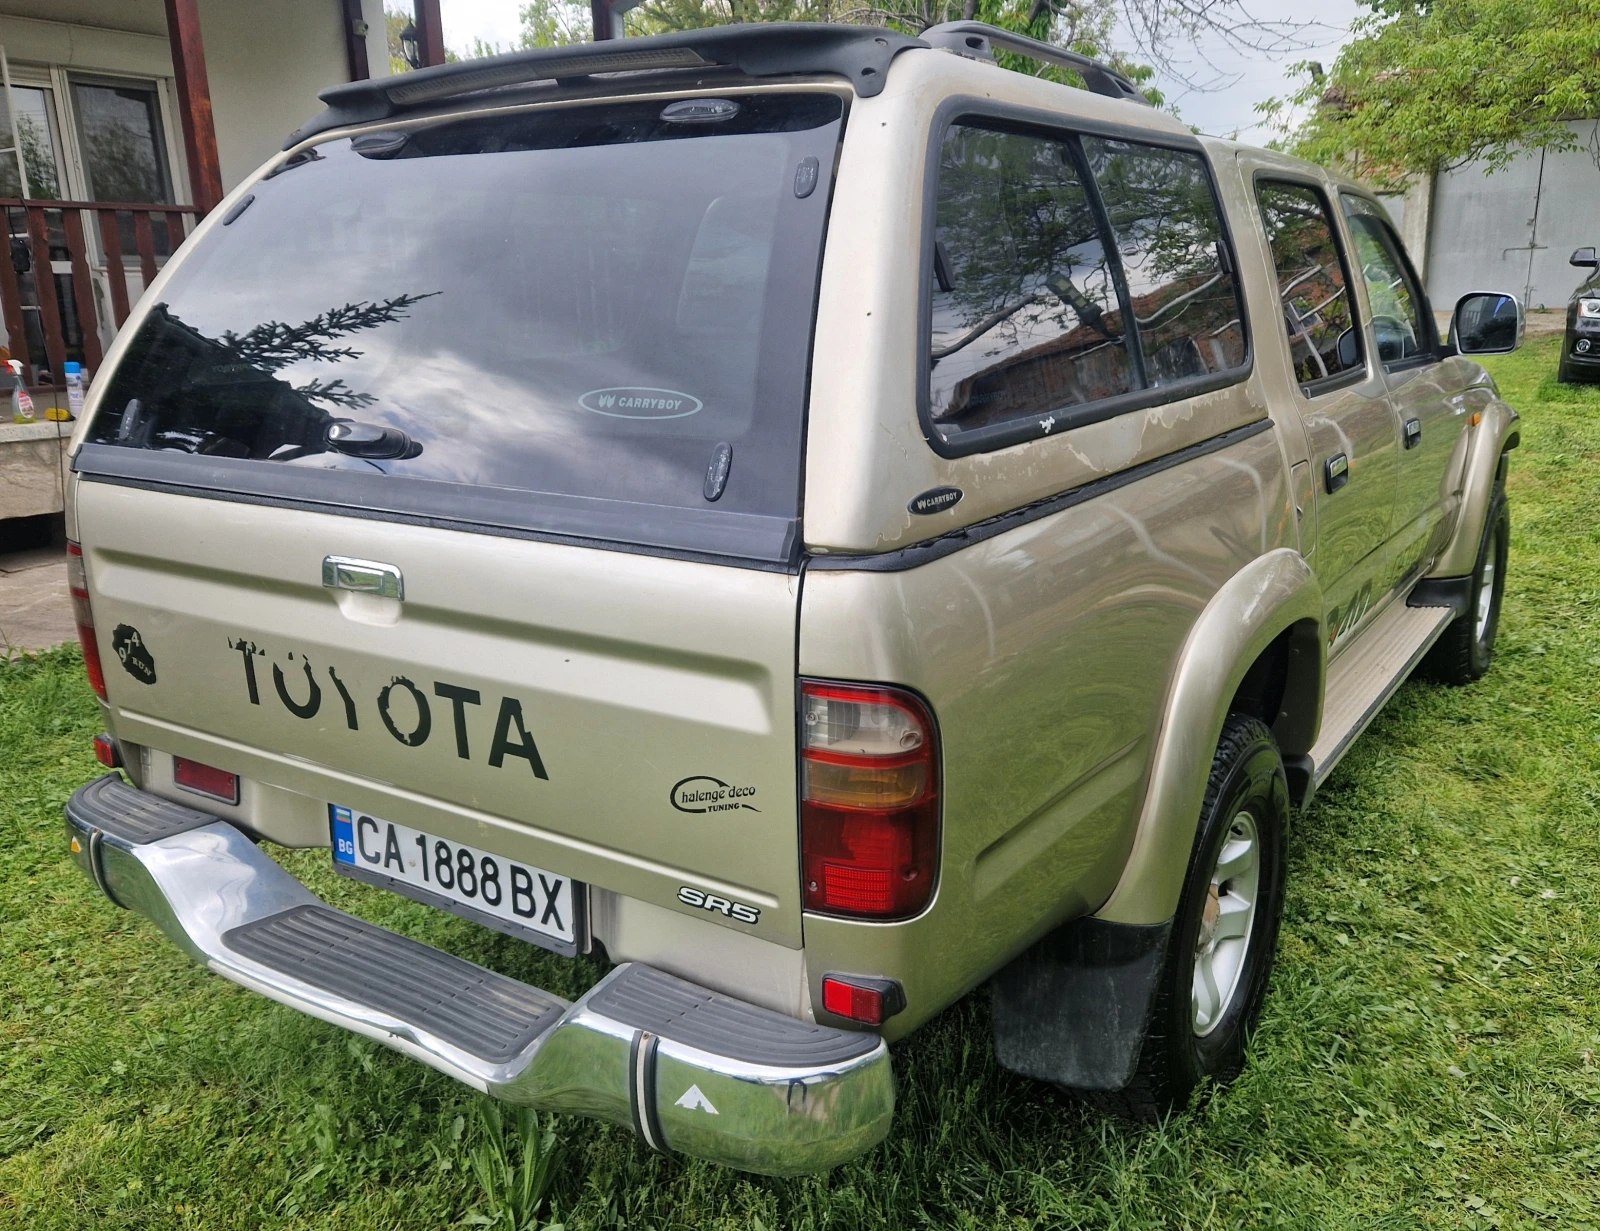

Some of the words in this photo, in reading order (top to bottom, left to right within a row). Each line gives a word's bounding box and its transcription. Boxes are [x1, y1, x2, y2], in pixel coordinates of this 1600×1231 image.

[618, 397, 682, 410] CARRYBOY
[926, 491, 957, 507] CARRYBOY
[132, 656, 152, 676] RUN
[728, 786, 756, 798] deco
[707, 803, 740, 813] TUNING
[338, 838, 353, 855] BG
[357, 816, 405, 873] CA
[416, 834, 502, 906] 1888
[510, 864, 565, 931] BX
[677, 886, 761, 924] SR5
